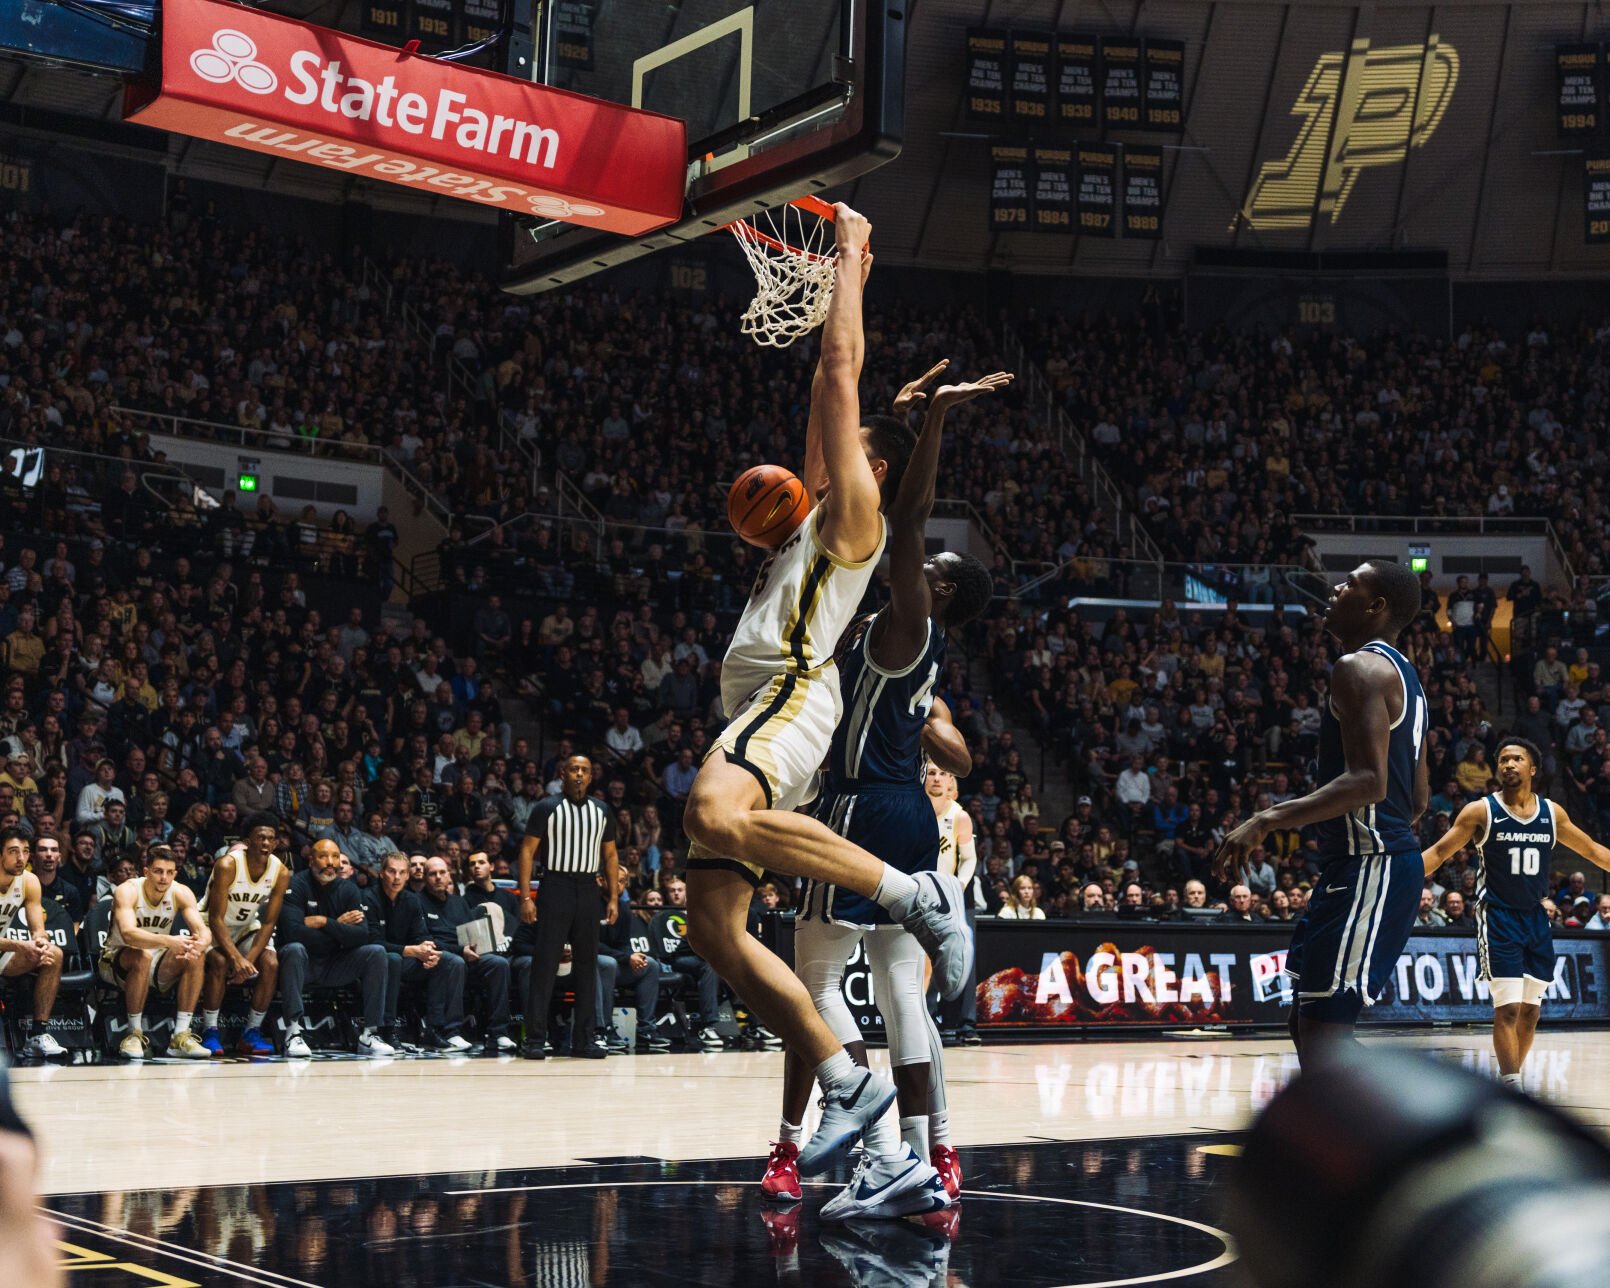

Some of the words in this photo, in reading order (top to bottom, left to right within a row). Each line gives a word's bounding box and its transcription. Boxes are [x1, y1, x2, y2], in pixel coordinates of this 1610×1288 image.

[370, 7, 398, 26] 1911
[418, 15, 448, 36] 1912
[970, 97, 1001, 113] 1935
[1015, 100, 1046, 117] 1936
[1061, 103, 1093, 118] 1938
[1106, 106, 1138, 121] 1940
[1148, 109, 1180, 124] 1969
[1561, 113, 1596, 129] 1994
[1586, 160, 1610, 170] PUR
[0, 162, 29, 192] 01
[1592, 182, 1610, 191] MEN
[1587, 201, 1610, 211] CHA
[994, 208, 1026, 222] 1979
[1037, 210, 1070, 225] 1984
[1080, 212, 1111, 228] 1987
[1127, 215, 1159, 230] 1988
[1590, 220, 1610, 235] 20
[671, 265, 706, 289] 102
[1299, 302, 1335, 323] 103
[1496, 832, 1551, 843] SAMFORD
[1508, 847, 1540, 876] 10
[136, 915, 173, 929] URDU
[236, 908, 251, 922] 5
[1035, 952, 1073, 1004] A
[1086, 952, 1236, 1004] GREAT
[1395, 954, 1442, 1001] TO
[1455, 954, 1572, 1001] WK
